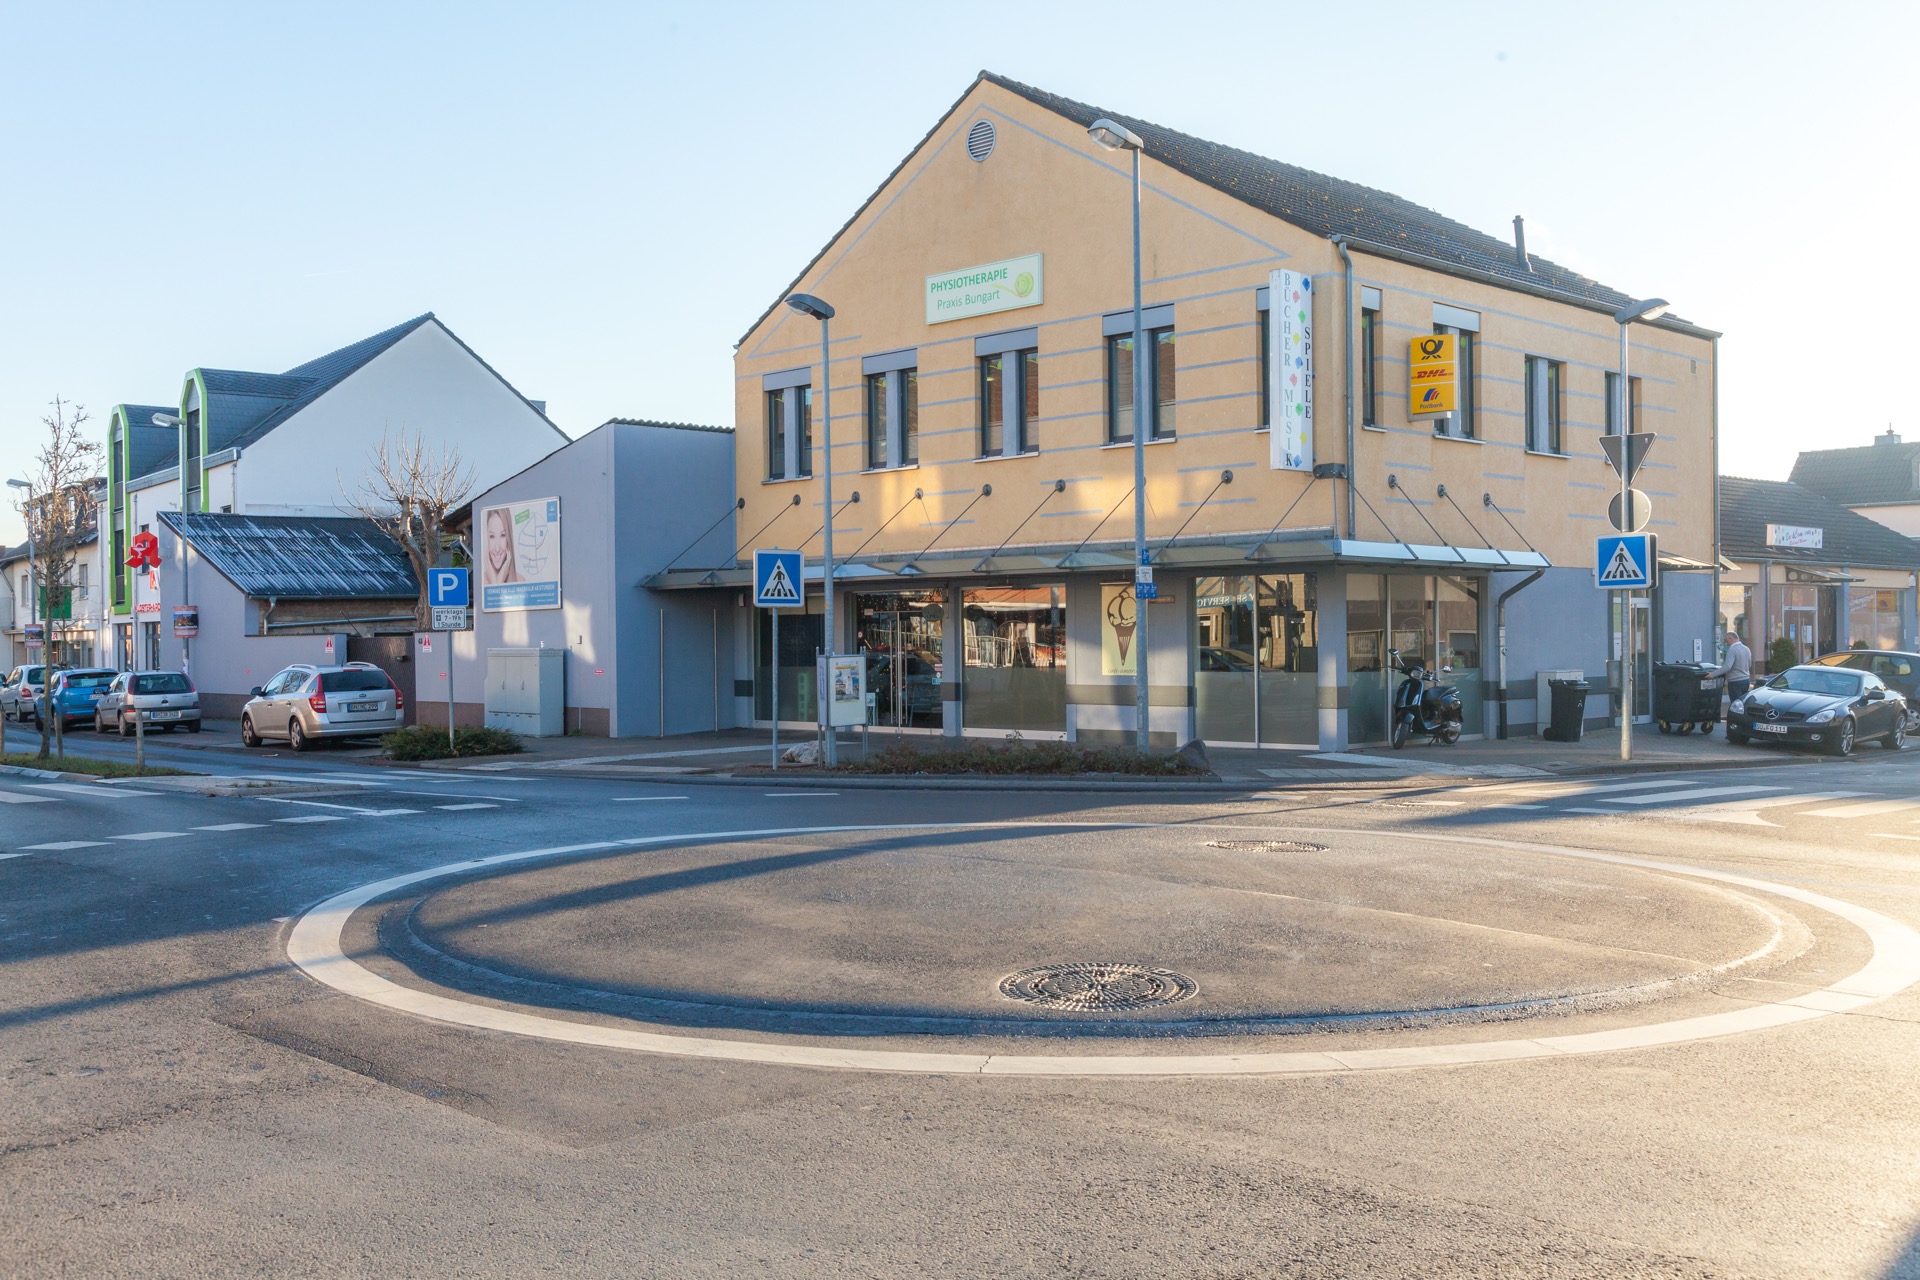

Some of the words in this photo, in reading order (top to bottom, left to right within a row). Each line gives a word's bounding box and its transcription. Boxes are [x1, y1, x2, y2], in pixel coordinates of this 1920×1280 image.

[930, 267, 1008, 293] PHYSIOTHERAPIE
[937, 295, 963, 310] Praxis
[965, 289, 1000, 304] Bungart
[1283, 272, 1291, 367] BÜCHER
[1416, 368, 1448, 379] DHL
[1284, 388, 1293, 467] MUSIK
[438, 573, 458, 601] P
